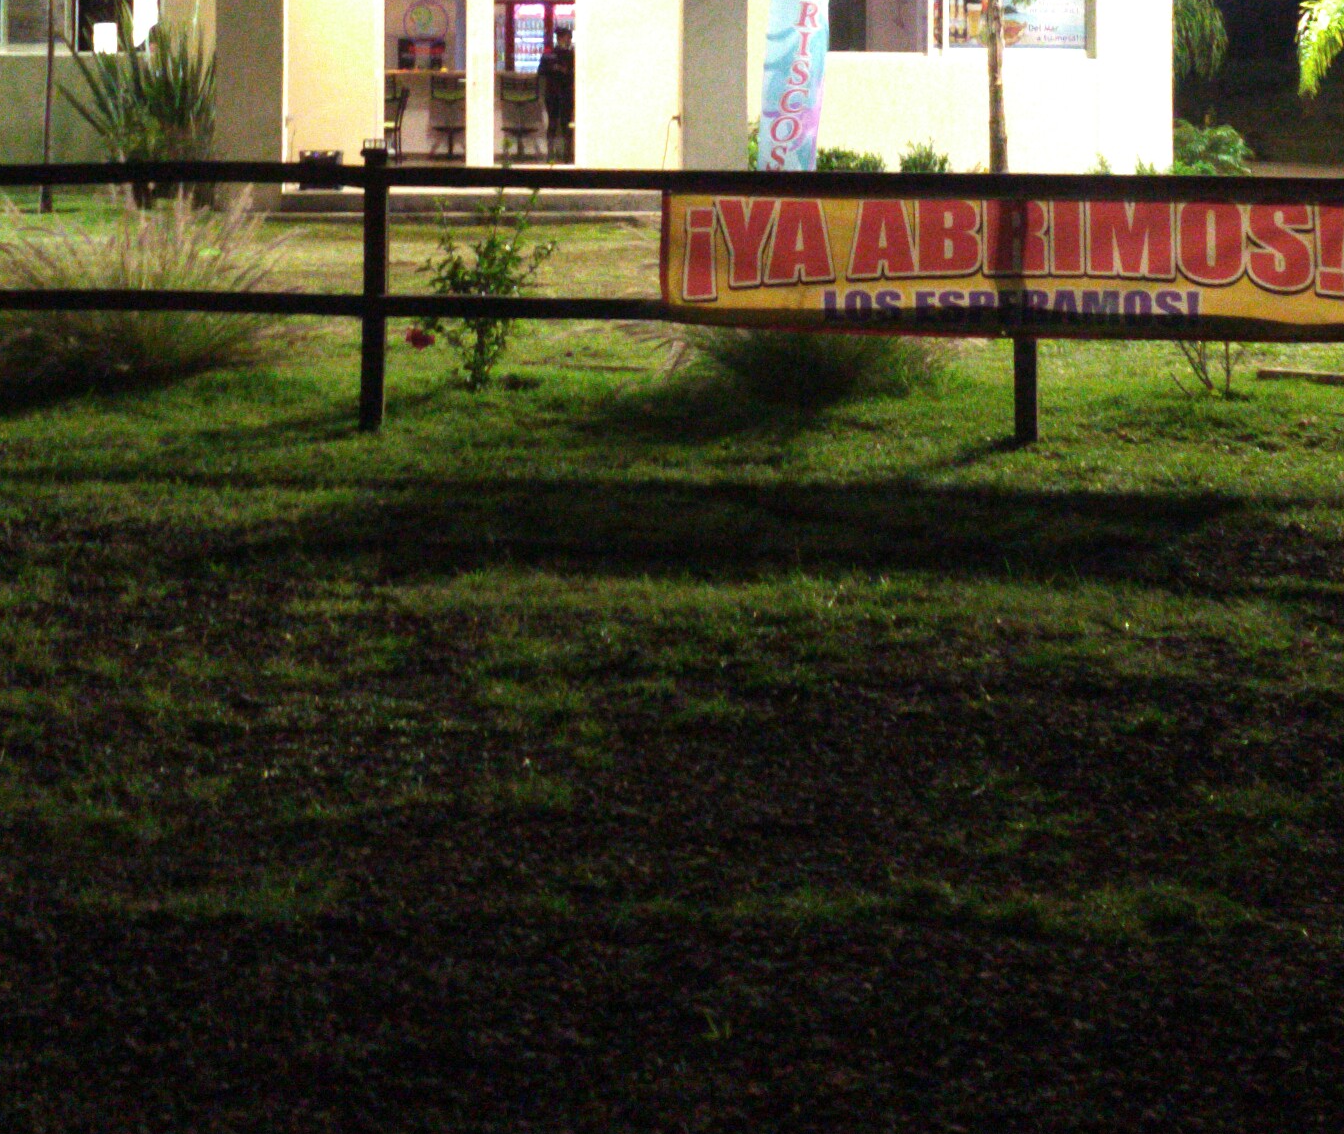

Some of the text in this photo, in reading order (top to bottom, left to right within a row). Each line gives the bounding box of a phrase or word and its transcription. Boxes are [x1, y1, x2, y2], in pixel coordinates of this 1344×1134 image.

[682, 196, 836, 302] ¡YA
[823, 288, 1201, 325] LOS ESPERAMOS!
